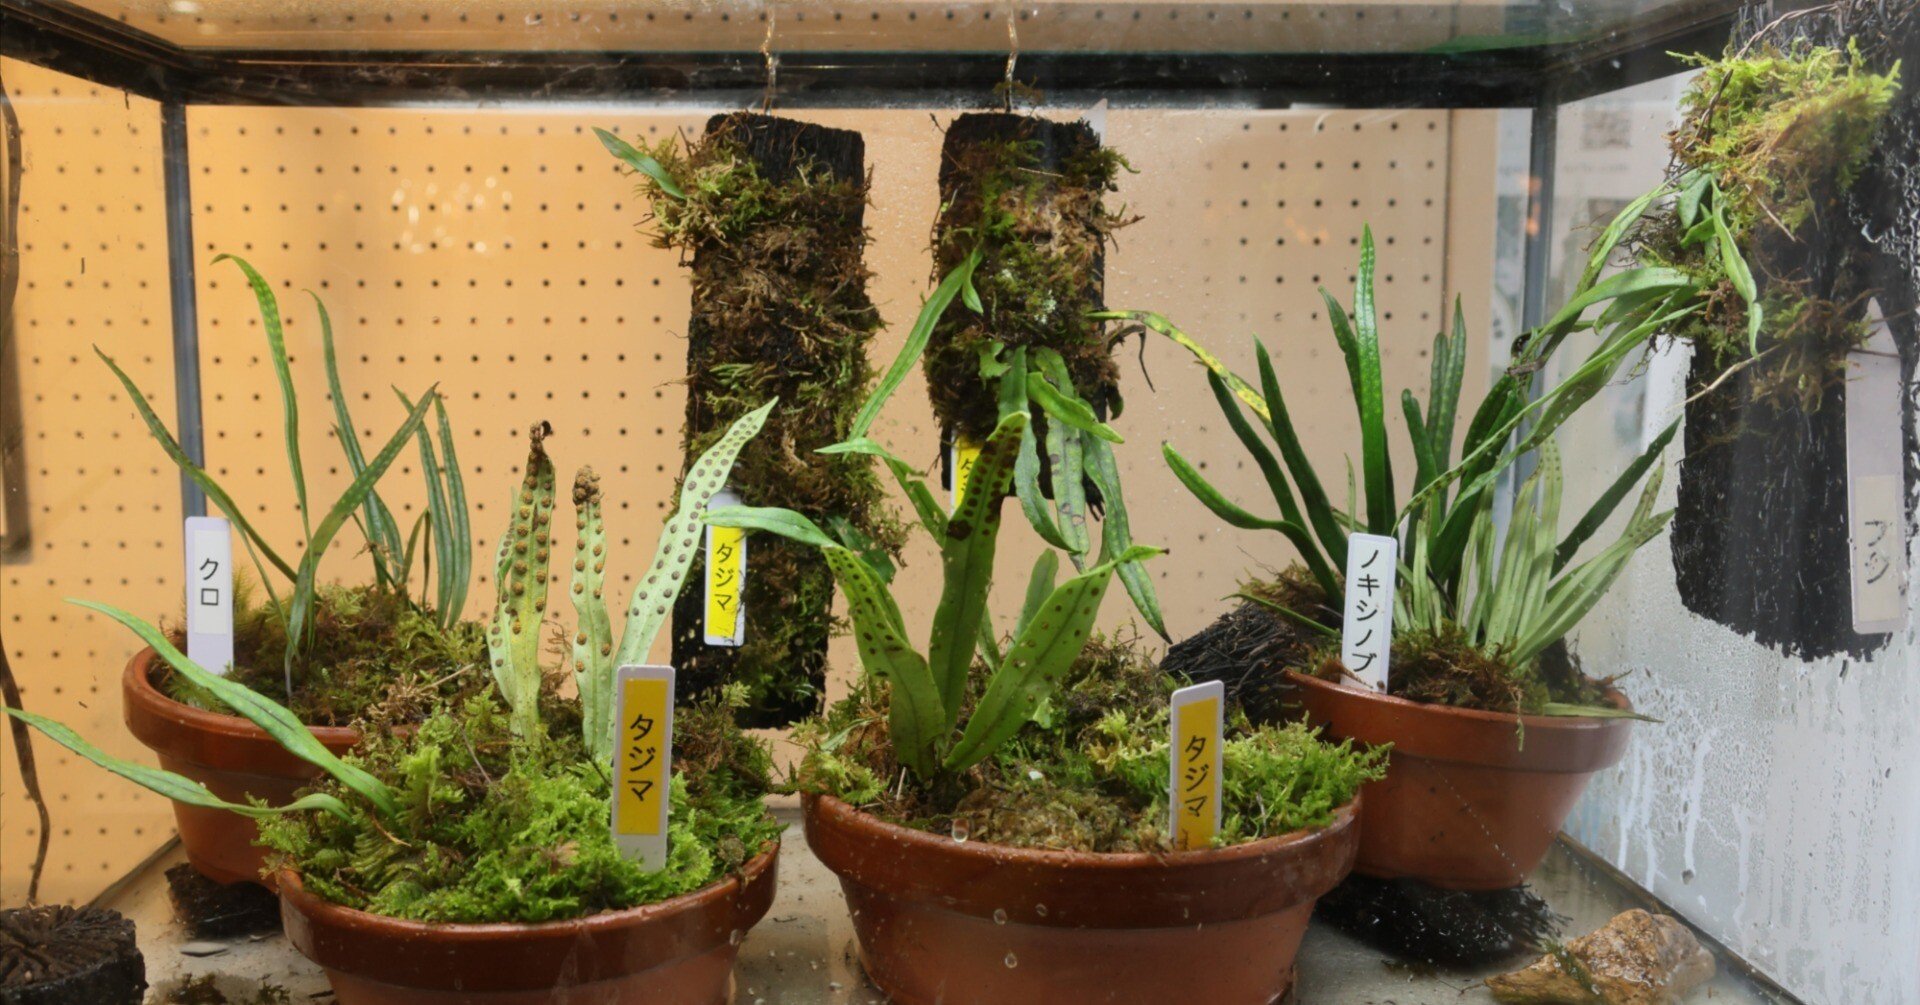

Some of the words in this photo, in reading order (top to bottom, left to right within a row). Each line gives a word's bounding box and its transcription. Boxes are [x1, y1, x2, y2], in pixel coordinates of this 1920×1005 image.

[200, 557, 220, 606] クロ
[714, 543, 734, 611] タジマ
[1352, 549, 1380, 673] ノキシノブ
[628, 714, 656, 802] タジマ
[1184, 735, 1210, 818] タジマ
